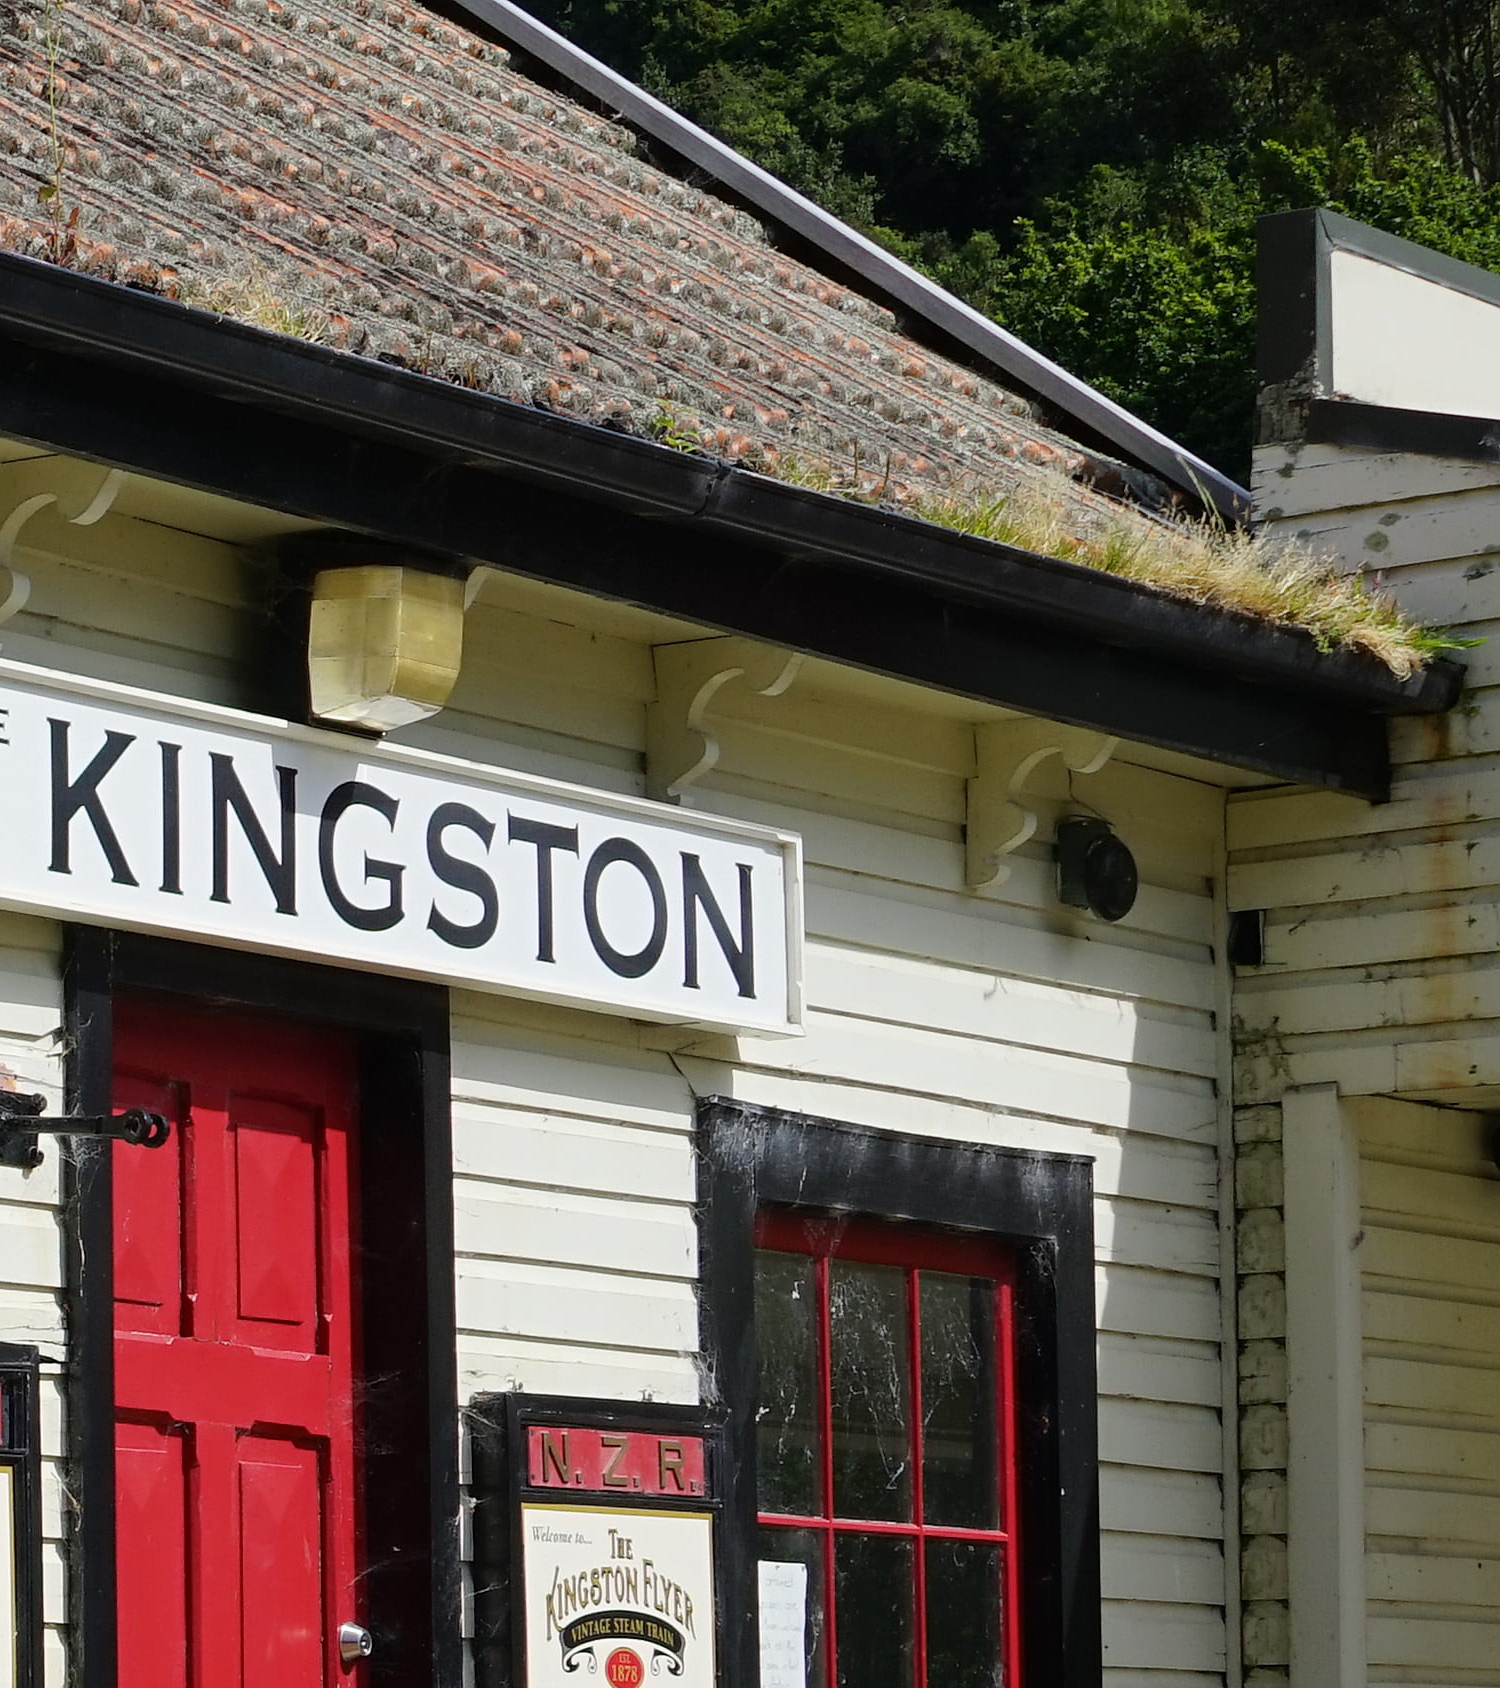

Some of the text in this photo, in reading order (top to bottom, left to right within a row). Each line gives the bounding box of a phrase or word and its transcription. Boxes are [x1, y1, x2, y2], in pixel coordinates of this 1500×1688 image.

[47, 717, 757, 999] KINGSTON
[531, 1525, 572, 1545] Welcome
[546, 1565, 638, 1642] KINGSTON
[642, 1558, 697, 1641] FLYER
[570, 1618, 675, 1647] VINTAGE STEAM TRAIN
[611, 1665, 638, 1683] 1878
